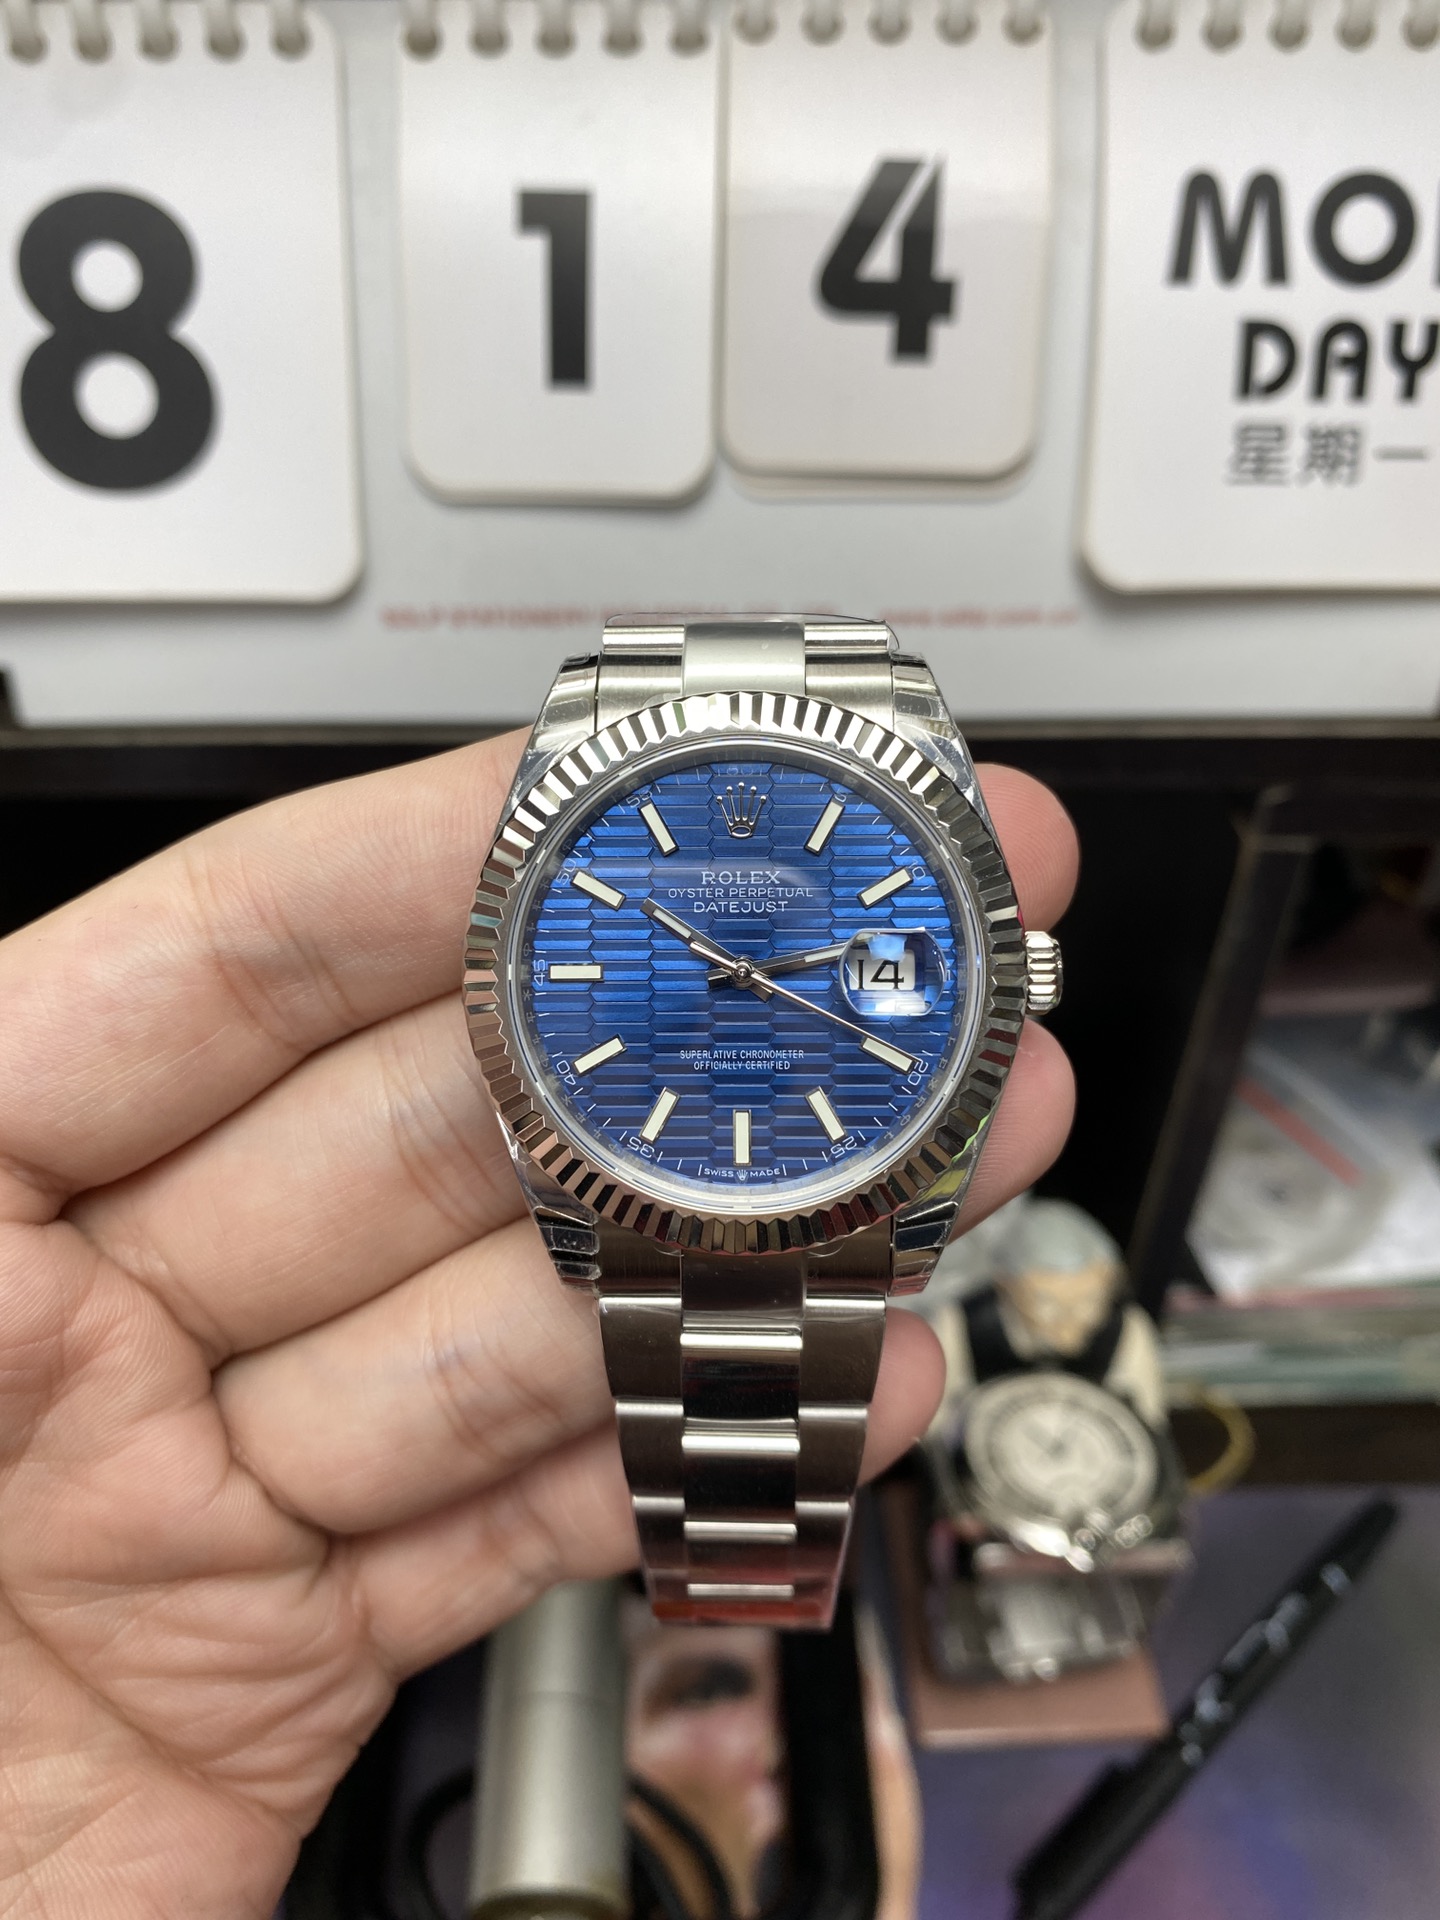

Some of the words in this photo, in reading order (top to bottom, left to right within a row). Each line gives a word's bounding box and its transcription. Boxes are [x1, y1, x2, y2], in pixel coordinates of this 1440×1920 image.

[1166, 171, 1440, 286] MO
[816, 157, 955, 362] 4
[517, 188, 592, 390] 1
[17, 188, 218, 491] 8
[1235, 319, 1440, 402] DAY
[1228, 424, 1430, 486] 星期一
[555, 858, 576, 886] 50
[701, 870, 781, 885] ROLEX
[668, 887, 724, 898] OYSTER
[729, 887, 814, 898] PERPETUAL
[693, 901, 788, 913] DATEJUST
[533, 959, 546, 986] 45
[857, 958, 905, 990] 14
[680, 1050, 737, 1059] SUPERLATIVE
[740, 1050, 804, 1059] CHRONOMETER
[693, 1060, 742, 1070] OFFICIALLY
[745, 1060, 791, 1070] CERTIFIED
[556, 1060, 577, 1085] 40
[907, 1059, 929, 1086] 20
[626, 1136, 655, 1158] 35
[830, 1135, 857, 1159] 25
[703, 1163, 734, 1177] SWISS
[749, 1163, 781, 1177] MADE
